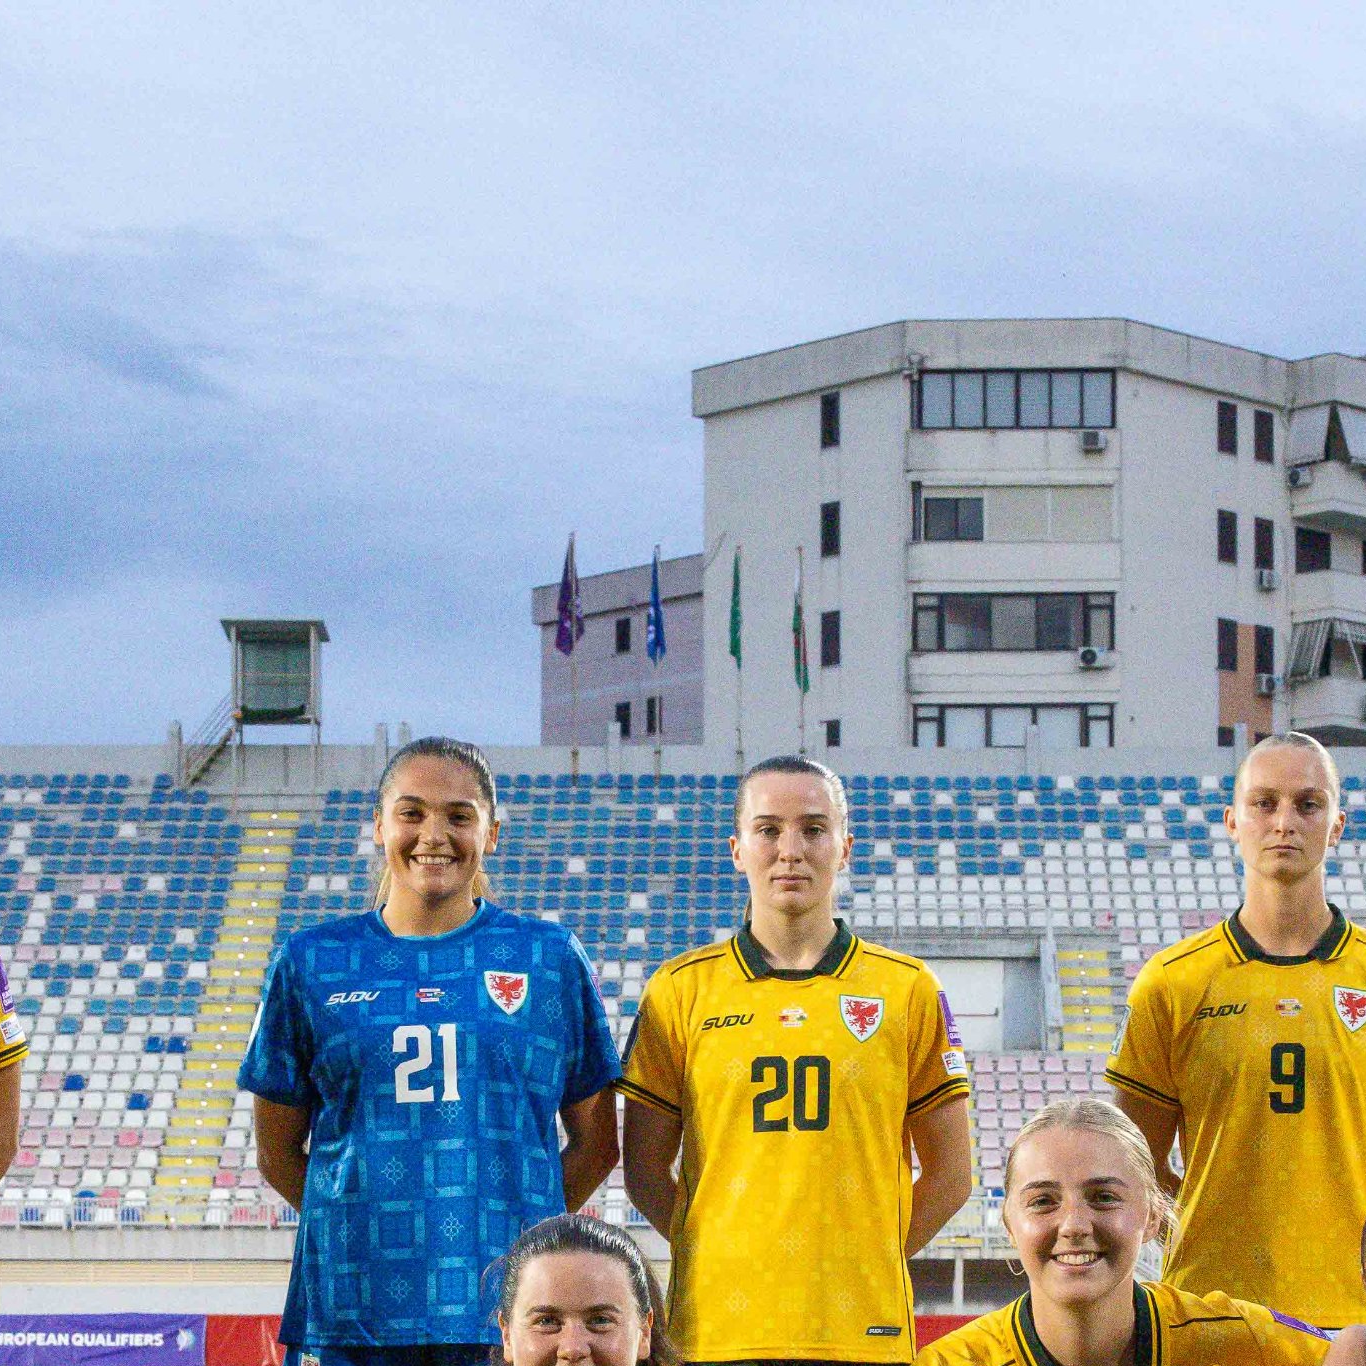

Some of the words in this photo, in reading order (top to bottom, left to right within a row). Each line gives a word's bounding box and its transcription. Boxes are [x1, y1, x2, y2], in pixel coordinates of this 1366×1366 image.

[326, 990, 381, 1006] SUDU
[1196, 1002, 1248, 1021] SUDU
[701, 1013, 755, 1031] SUDU
[392, 1023, 460, 1104] 21
[1269, 1042, 1306, 1114] 9
[750, 1055, 831, 1133] 20
[71, 1332, 164, 1347] QUALIFIERS
